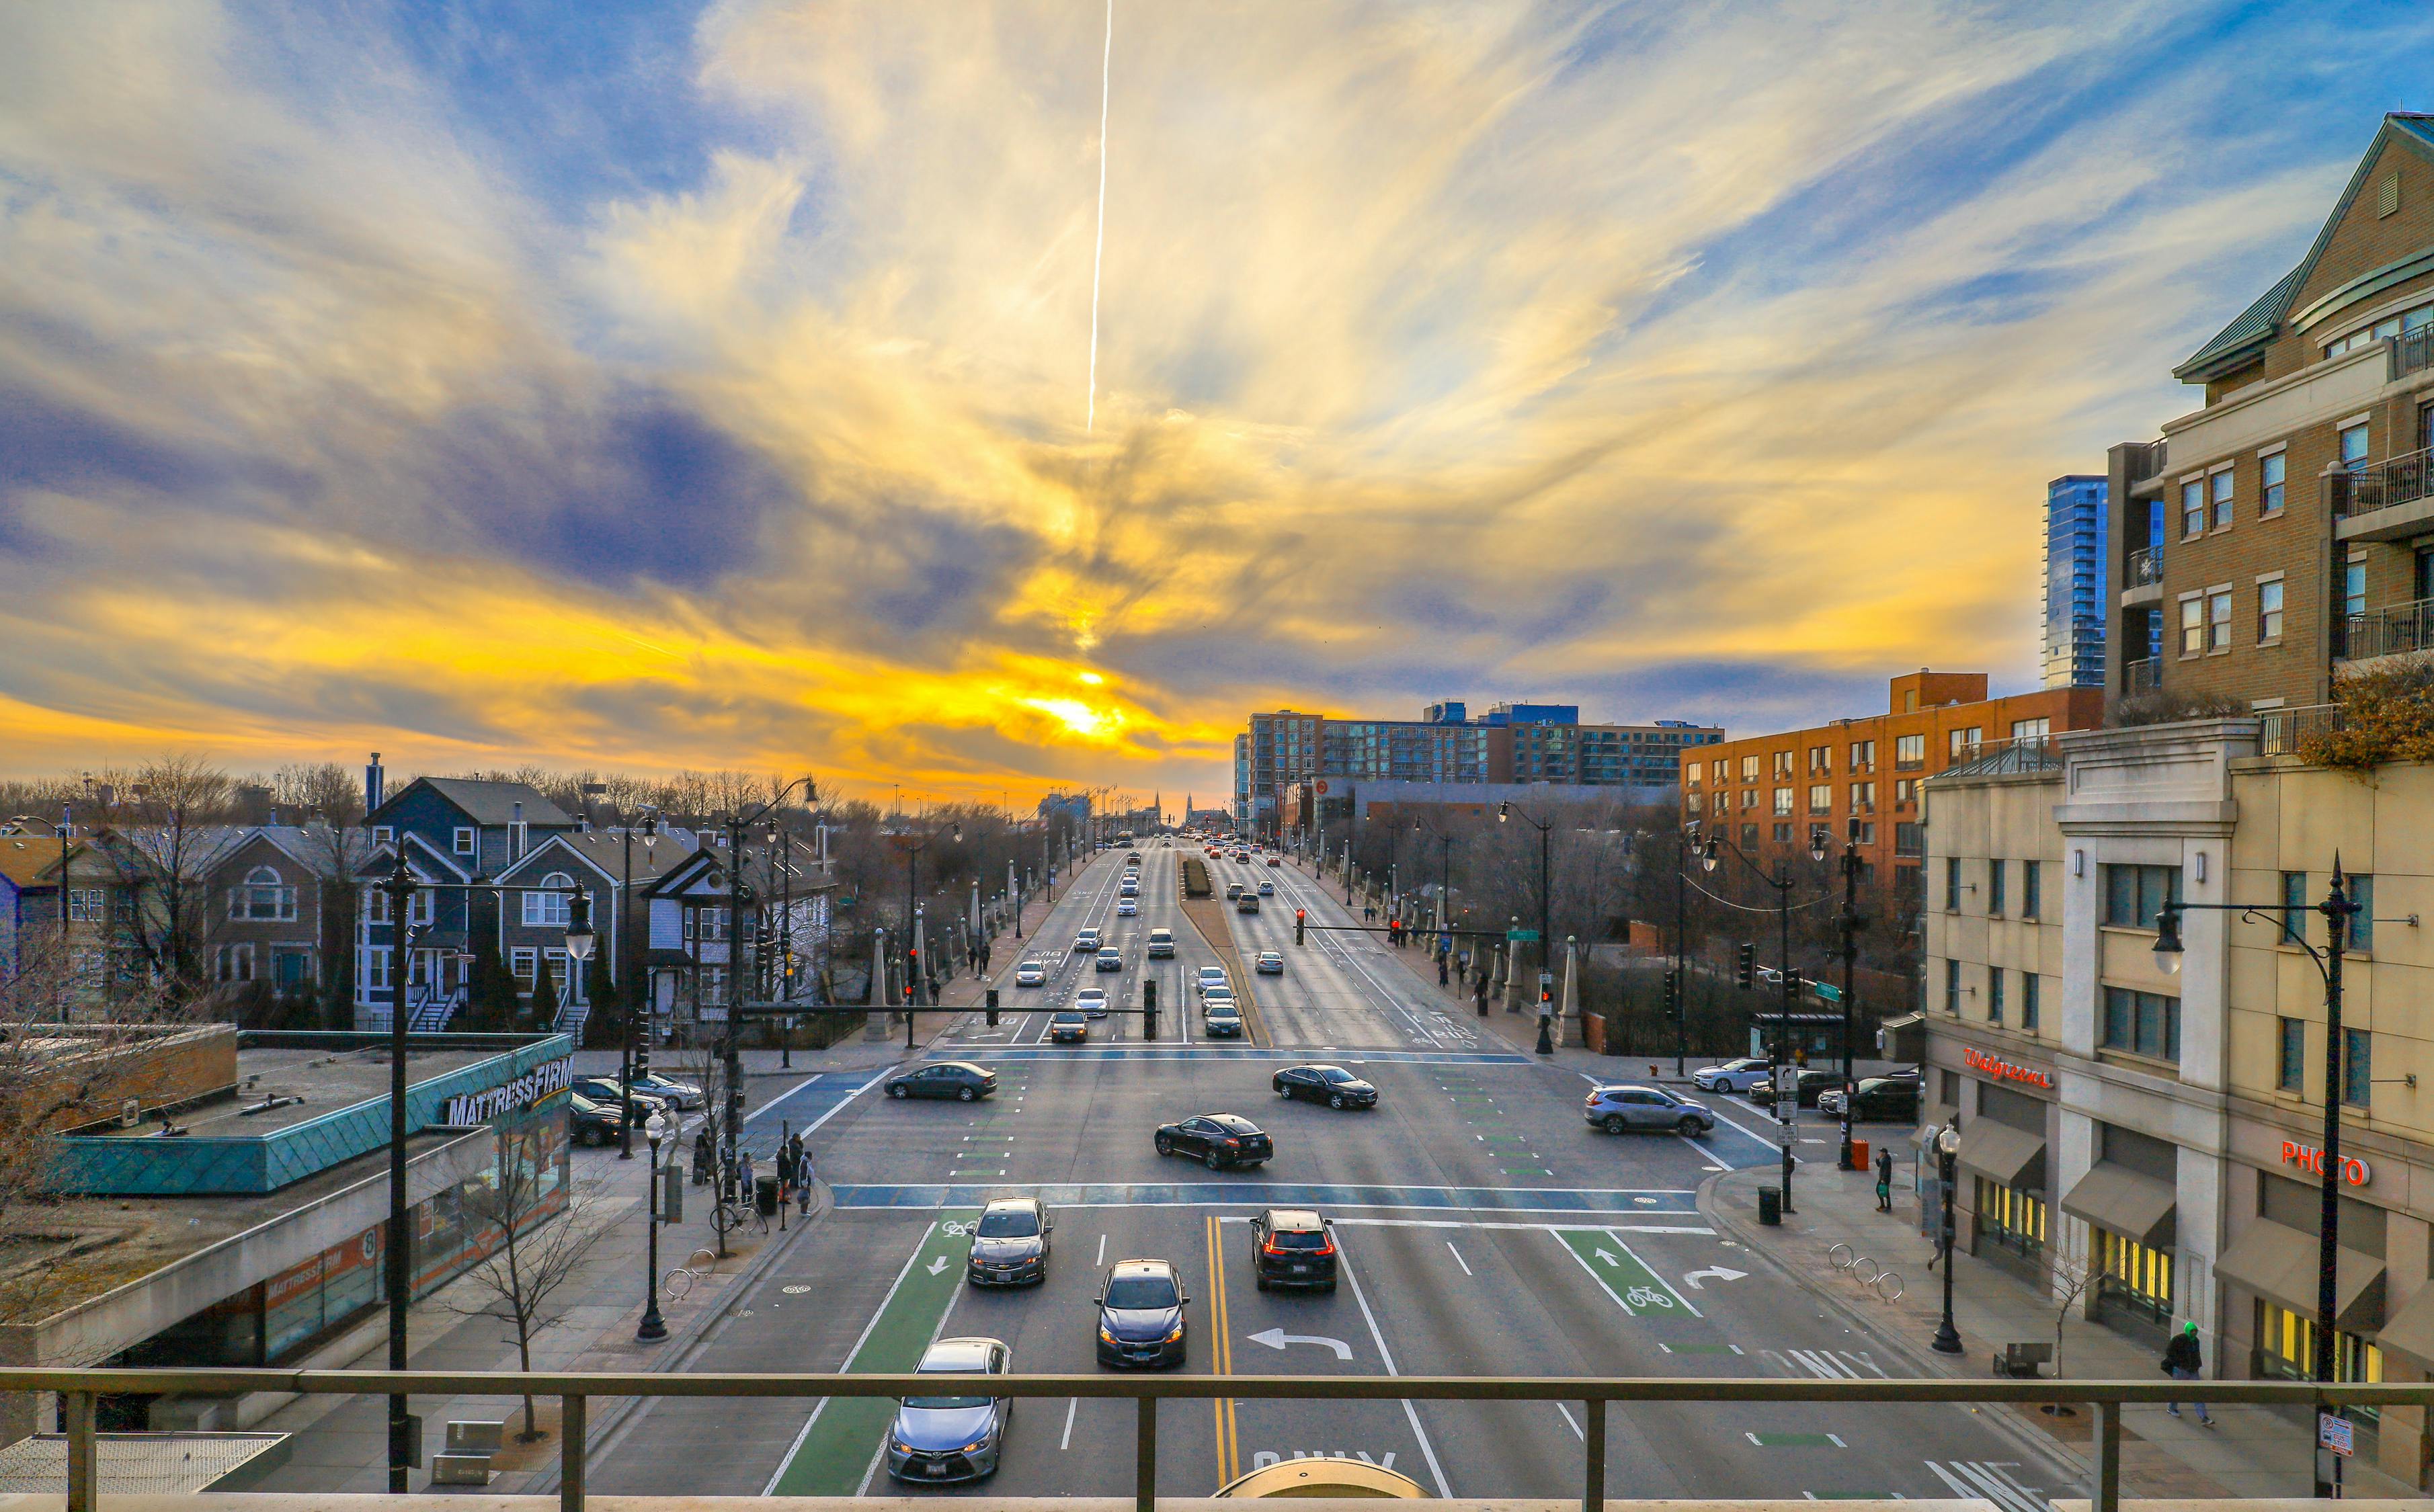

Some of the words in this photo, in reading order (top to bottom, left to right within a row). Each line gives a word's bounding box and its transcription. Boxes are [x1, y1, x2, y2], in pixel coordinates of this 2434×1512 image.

[1963, 1048, 2052, 1089] Walgreens
[2333, 1433, 2345, 1441] BUS
[2333, 1440, 2348, 1448] STOP
